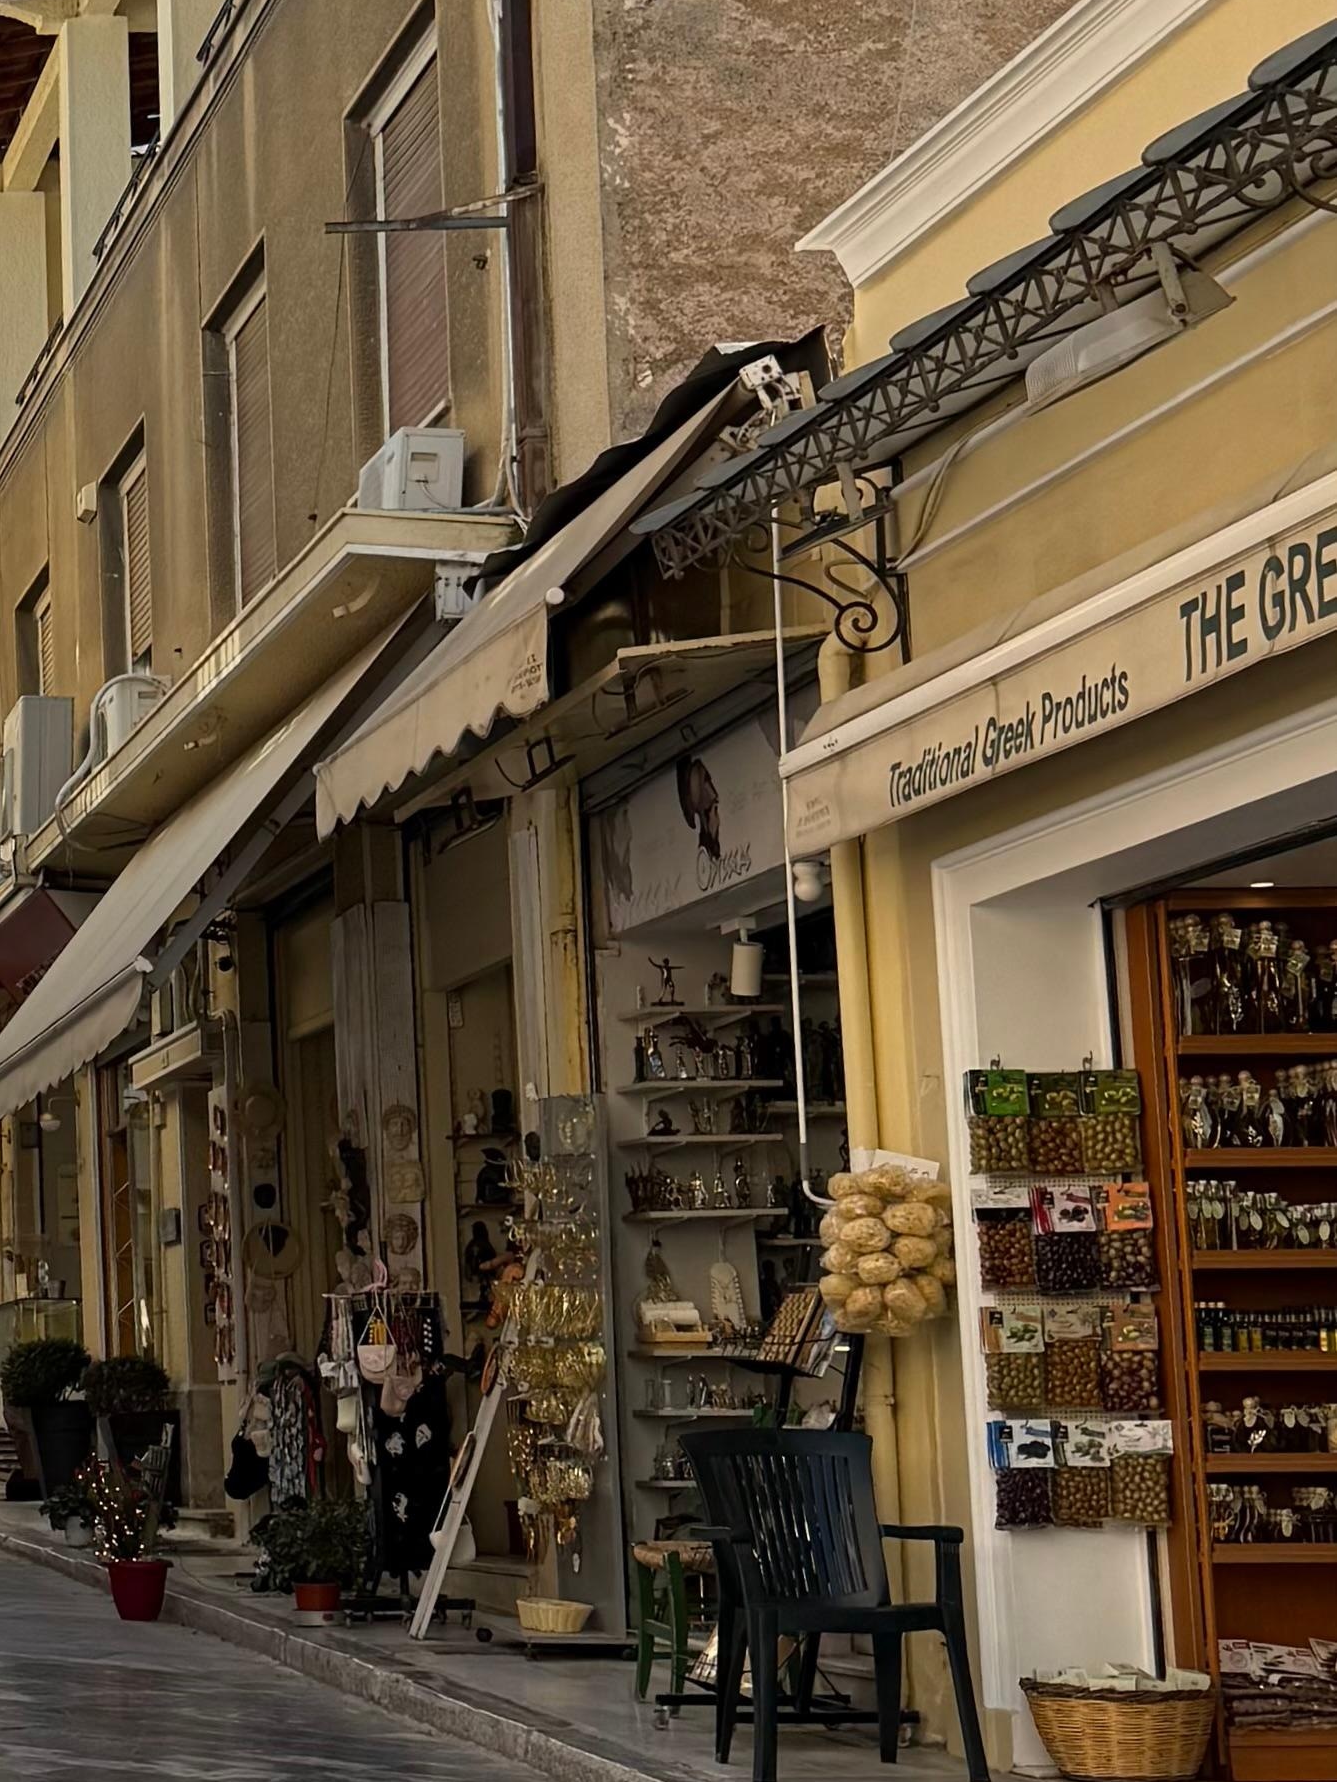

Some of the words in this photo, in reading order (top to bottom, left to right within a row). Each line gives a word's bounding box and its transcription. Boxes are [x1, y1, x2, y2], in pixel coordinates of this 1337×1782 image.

[1180, 570, 1248, 682] THE
[888, 726, 980, 808] Traditional
[982, 702, 1037, 768] Greek
[1040, 663, 1131, 746] Products
